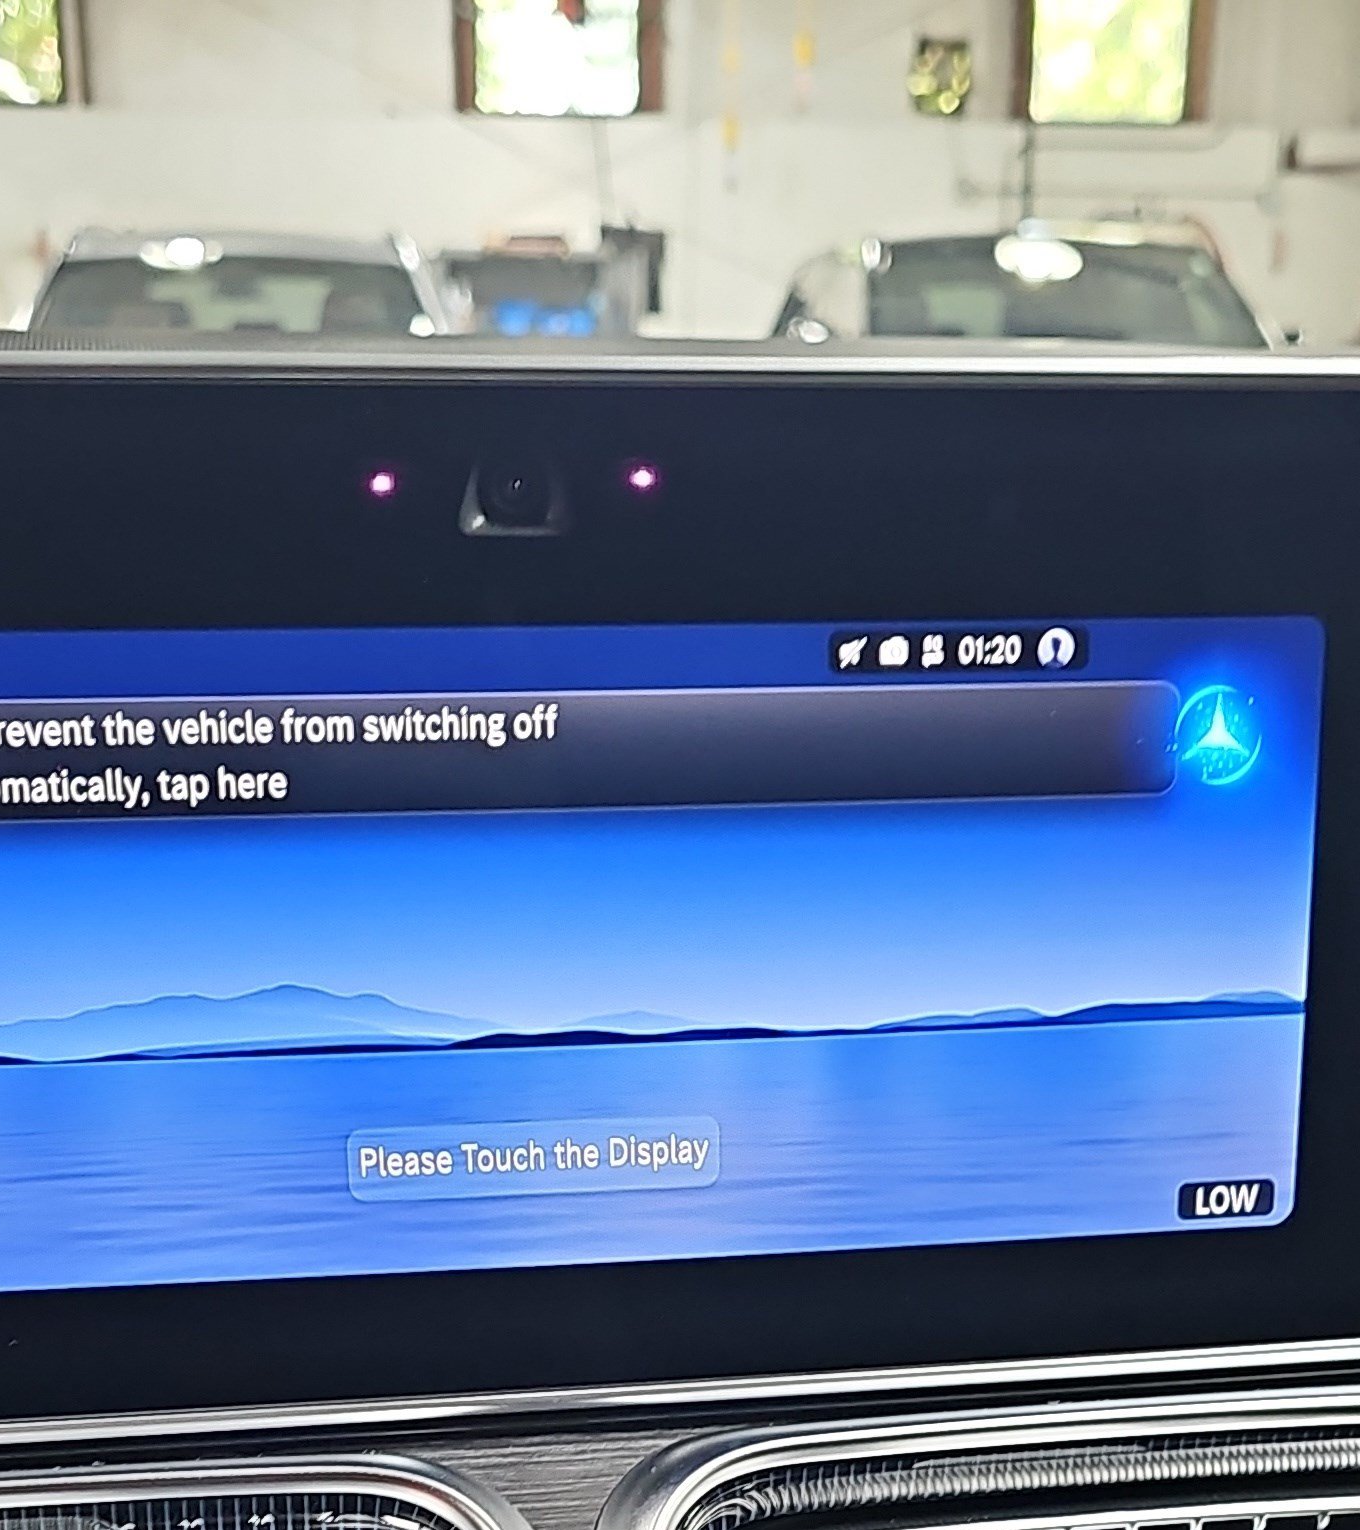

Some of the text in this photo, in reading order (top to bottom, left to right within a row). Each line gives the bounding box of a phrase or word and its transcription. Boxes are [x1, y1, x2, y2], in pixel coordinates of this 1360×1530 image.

[957, 633, 1023, 667] 01:20
[101, 709, 155, 747] the
[161, 708, 274, 746] vehicle
[280, 706, 356, 744] from
[362, 704, 507, 748] switching
[512, 702, 559, 741] off
[156, 768, 210, 809] tap
[216, 764, 289, 800] here
[358, 1132, 710, 1179] Please Touch the Display
[1194, 1182, 1261, 1216] LOW
